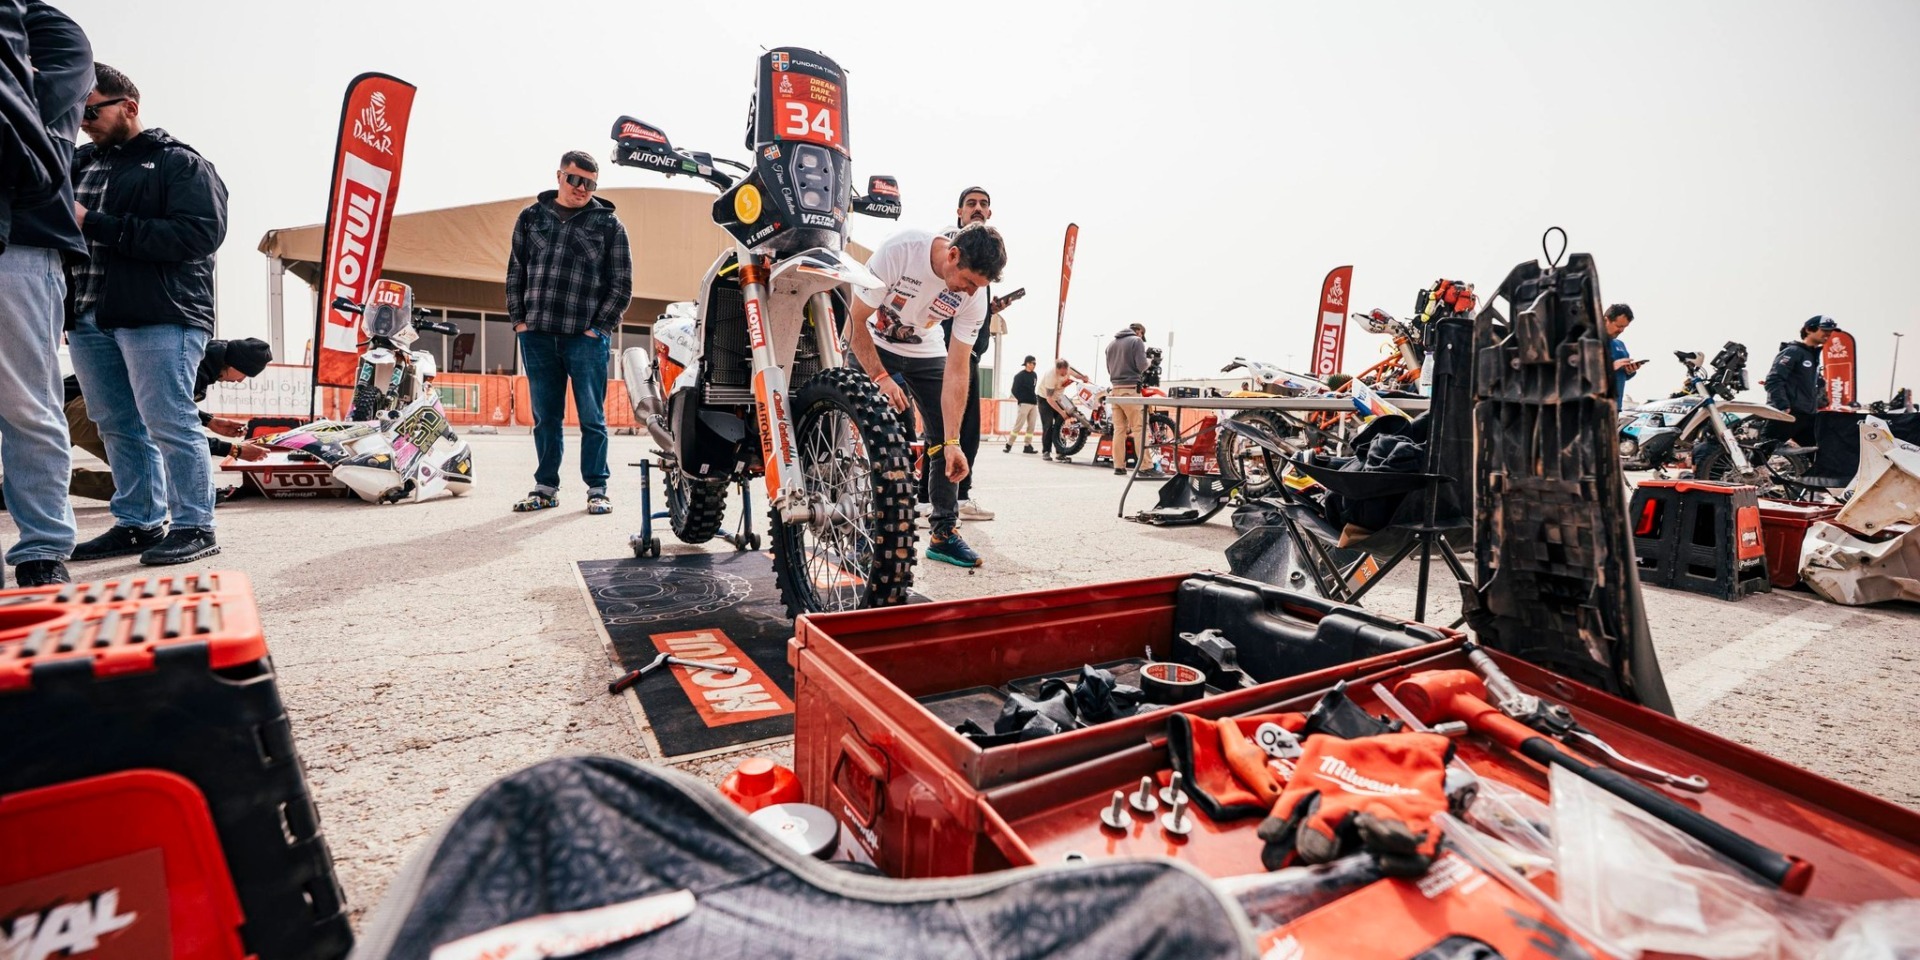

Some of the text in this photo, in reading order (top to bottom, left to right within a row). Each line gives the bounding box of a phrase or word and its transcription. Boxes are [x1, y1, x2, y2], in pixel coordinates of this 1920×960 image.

[810, 78, 836, 92] DREAM.
[811, 85, 831, 97] DARE.
[811, 93, 827, 103] LIVE
[621, 122, 666, 140] Milwaukee
[786, 102, 834, 141] 34
[353, 120, 393, 155] DAKAR
[334, 192, 377, 328] MOTUL
[377, 291, 400, 306] 101
[746, 302, 763, 346] MOTUL
[274, 473, 332, 487] 101
[664, 632, 782, 713] MOTUL
[1318, 755, 1422, 796] Milwaukee
